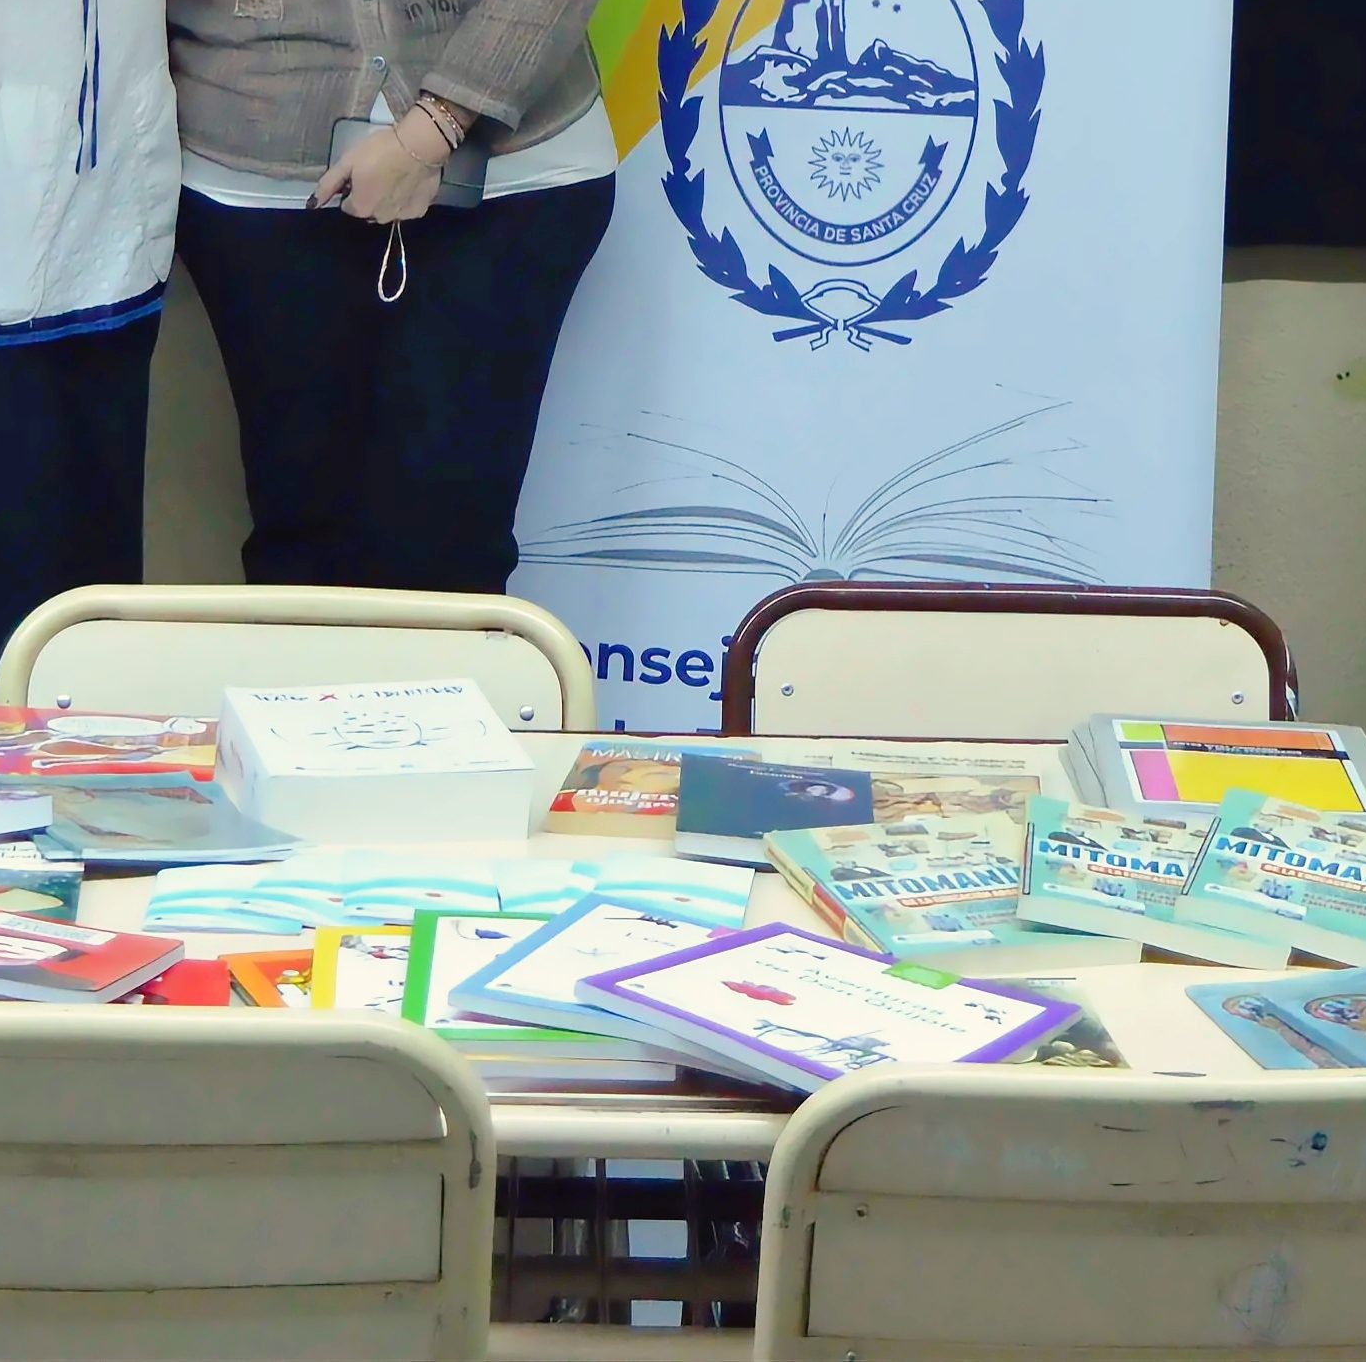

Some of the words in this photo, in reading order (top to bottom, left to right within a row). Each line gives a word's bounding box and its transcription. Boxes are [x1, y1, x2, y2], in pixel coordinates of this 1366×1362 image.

[753, 164, 820, 239] PROVINCIA
[823, 228, 848, 244] DE
[849, 212, 906, 243] SANTA
[901, 172, 939, 215] CRUZ
